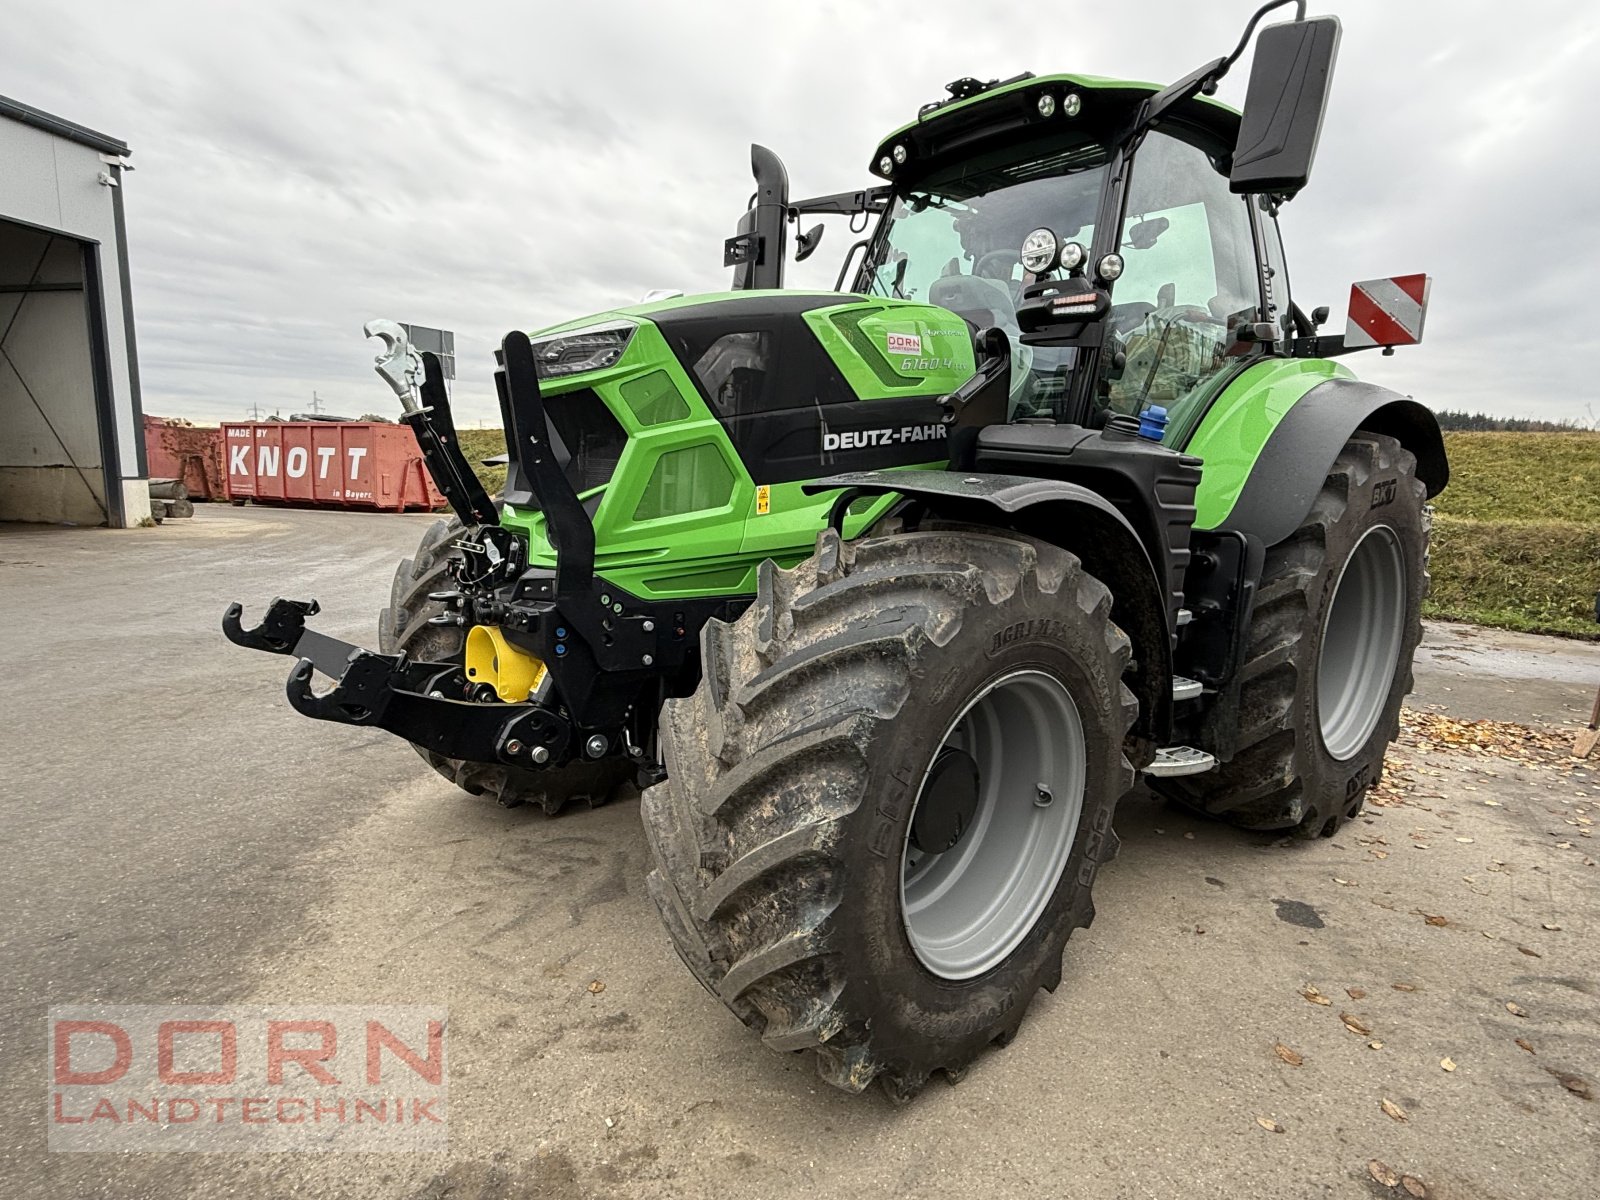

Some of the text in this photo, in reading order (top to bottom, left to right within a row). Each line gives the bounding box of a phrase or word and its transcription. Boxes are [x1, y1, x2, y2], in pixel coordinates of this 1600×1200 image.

[889, 336, 920, 347] DORN
[901, 358, 952, 370] 6160.4
[227, 428, 267, 438] MADE BY
[823, 424, 947, 451] DEUTZ-FAHR
[230, 445, 367, 480] KNOTT
[332, 489, 341, 497] in
[1371, 482, 1397, 508] BKT
